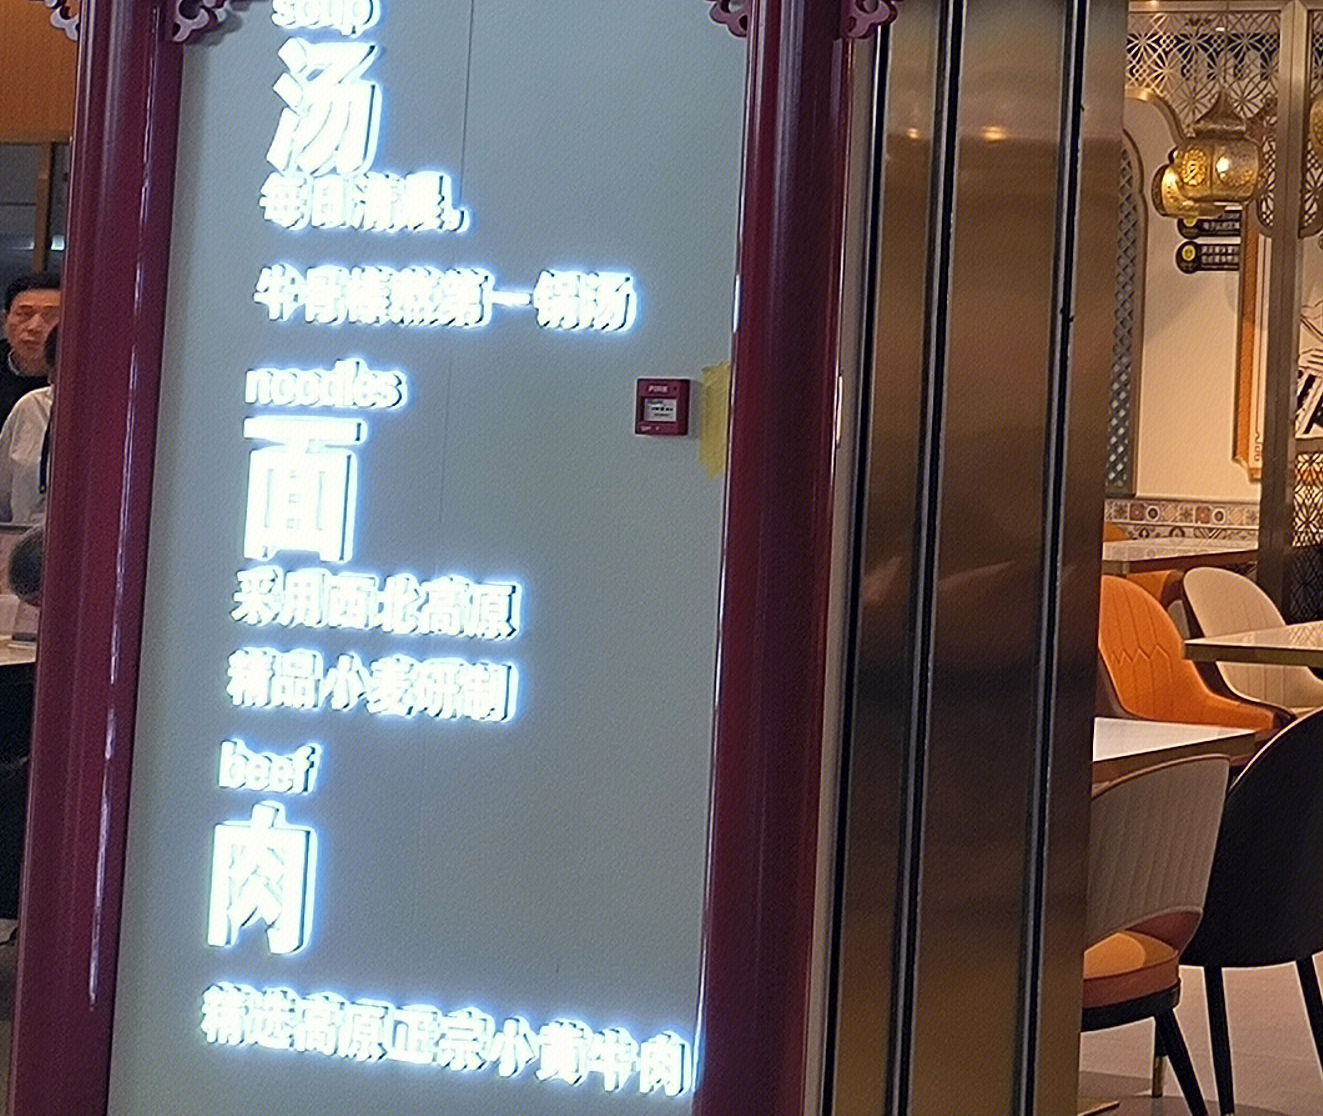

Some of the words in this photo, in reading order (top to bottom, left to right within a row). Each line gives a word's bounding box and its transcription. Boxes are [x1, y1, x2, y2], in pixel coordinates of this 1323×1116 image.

[266, 37, 382, 175] 汤
[245, 358, 407, 409] noodles
[243, 415, 368, 562] 面
[231, 566, 522, 640] 采用西北高原
[227, 647, 518, 722] 精品小麦研制
[219, 739, 322, 793] beef
[207, 802, 318, 955] 肉
[201, 983, 693, 1097] 精选高原正宗小黄牛肉
